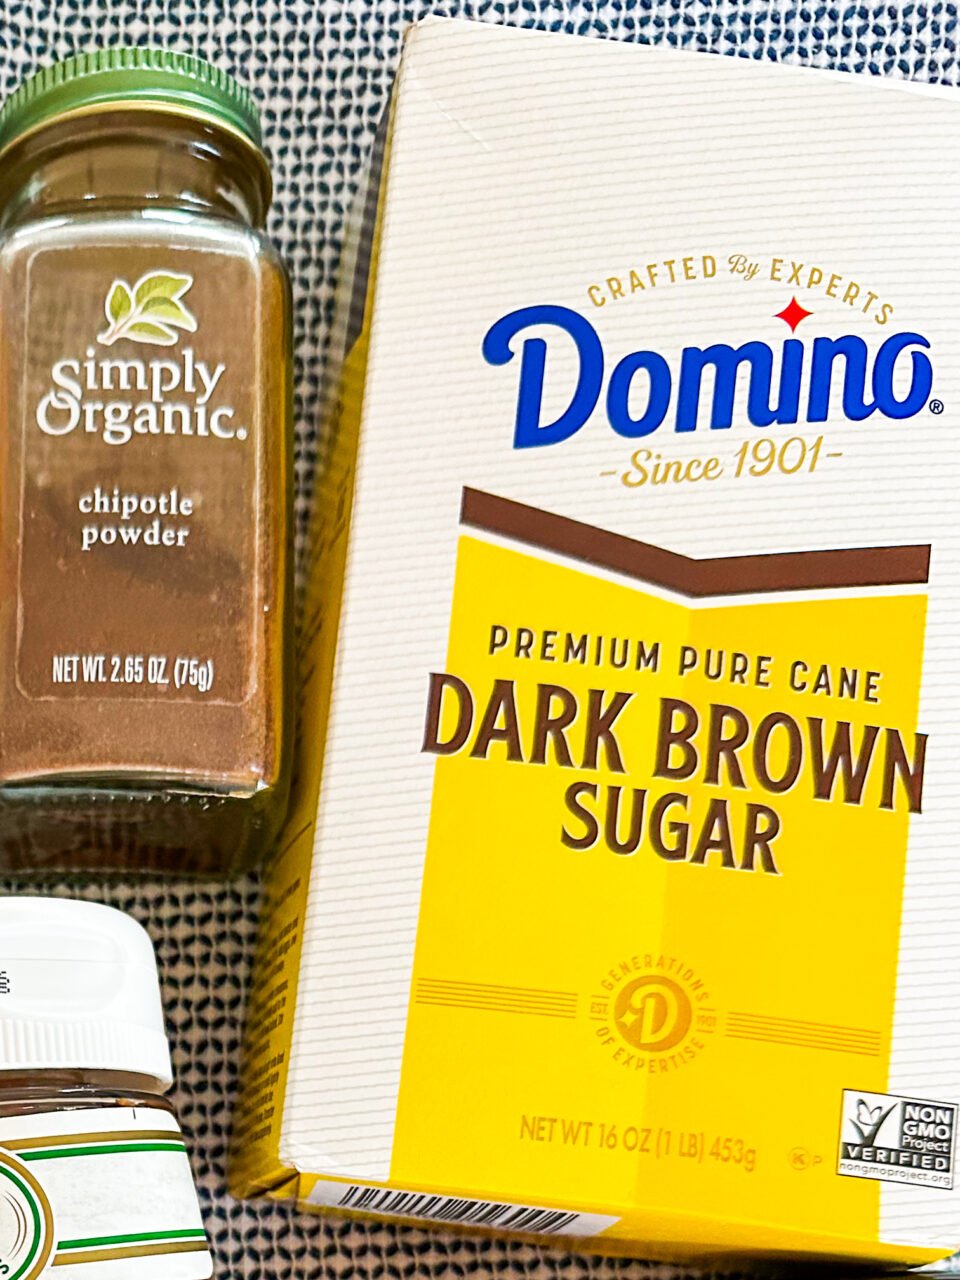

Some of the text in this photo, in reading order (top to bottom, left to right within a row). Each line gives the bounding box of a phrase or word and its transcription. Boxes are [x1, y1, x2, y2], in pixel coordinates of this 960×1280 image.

[587, 254, 895, 325] CRAFTED By EXPERTS
[51, 346, 225, 403] Simply
[482, 300, 934, 449] Domino
[78, 485, 194, 519] chipotle
[80, 519, 189, 551] powder
[52, 655, 215, 692] NET WT. 2.65 OZ. (75g)
[489, 625, 882, 703] PREMIUM PURE CANE
[421, 672, 929, 814] DARK BROWN
[561, 781, 781, 875] SUGAR
[601, 953, 710, 1003] GENERATIONS
[612, 1036, 705, 1074] EXPERTISE
[903, 1121, 951, 1140] GMO
[904, 1105, 952, 1124] NON
[520, 1114, 555, 1143] NET
[561, 1118, 593, 1147] WT
[599, 1122, 618, 1151] 16
[623, 1125, 653, 1154] OZ
[679, 1129, 705, 1164] LB)
[709, 1135, 757, 1173] 453g
[846, 1145, 948, 1170] VERIFIED
[901, 1135, 949, 1153] Project
[839, 1161, 952, 1186] nongmoproject.org
